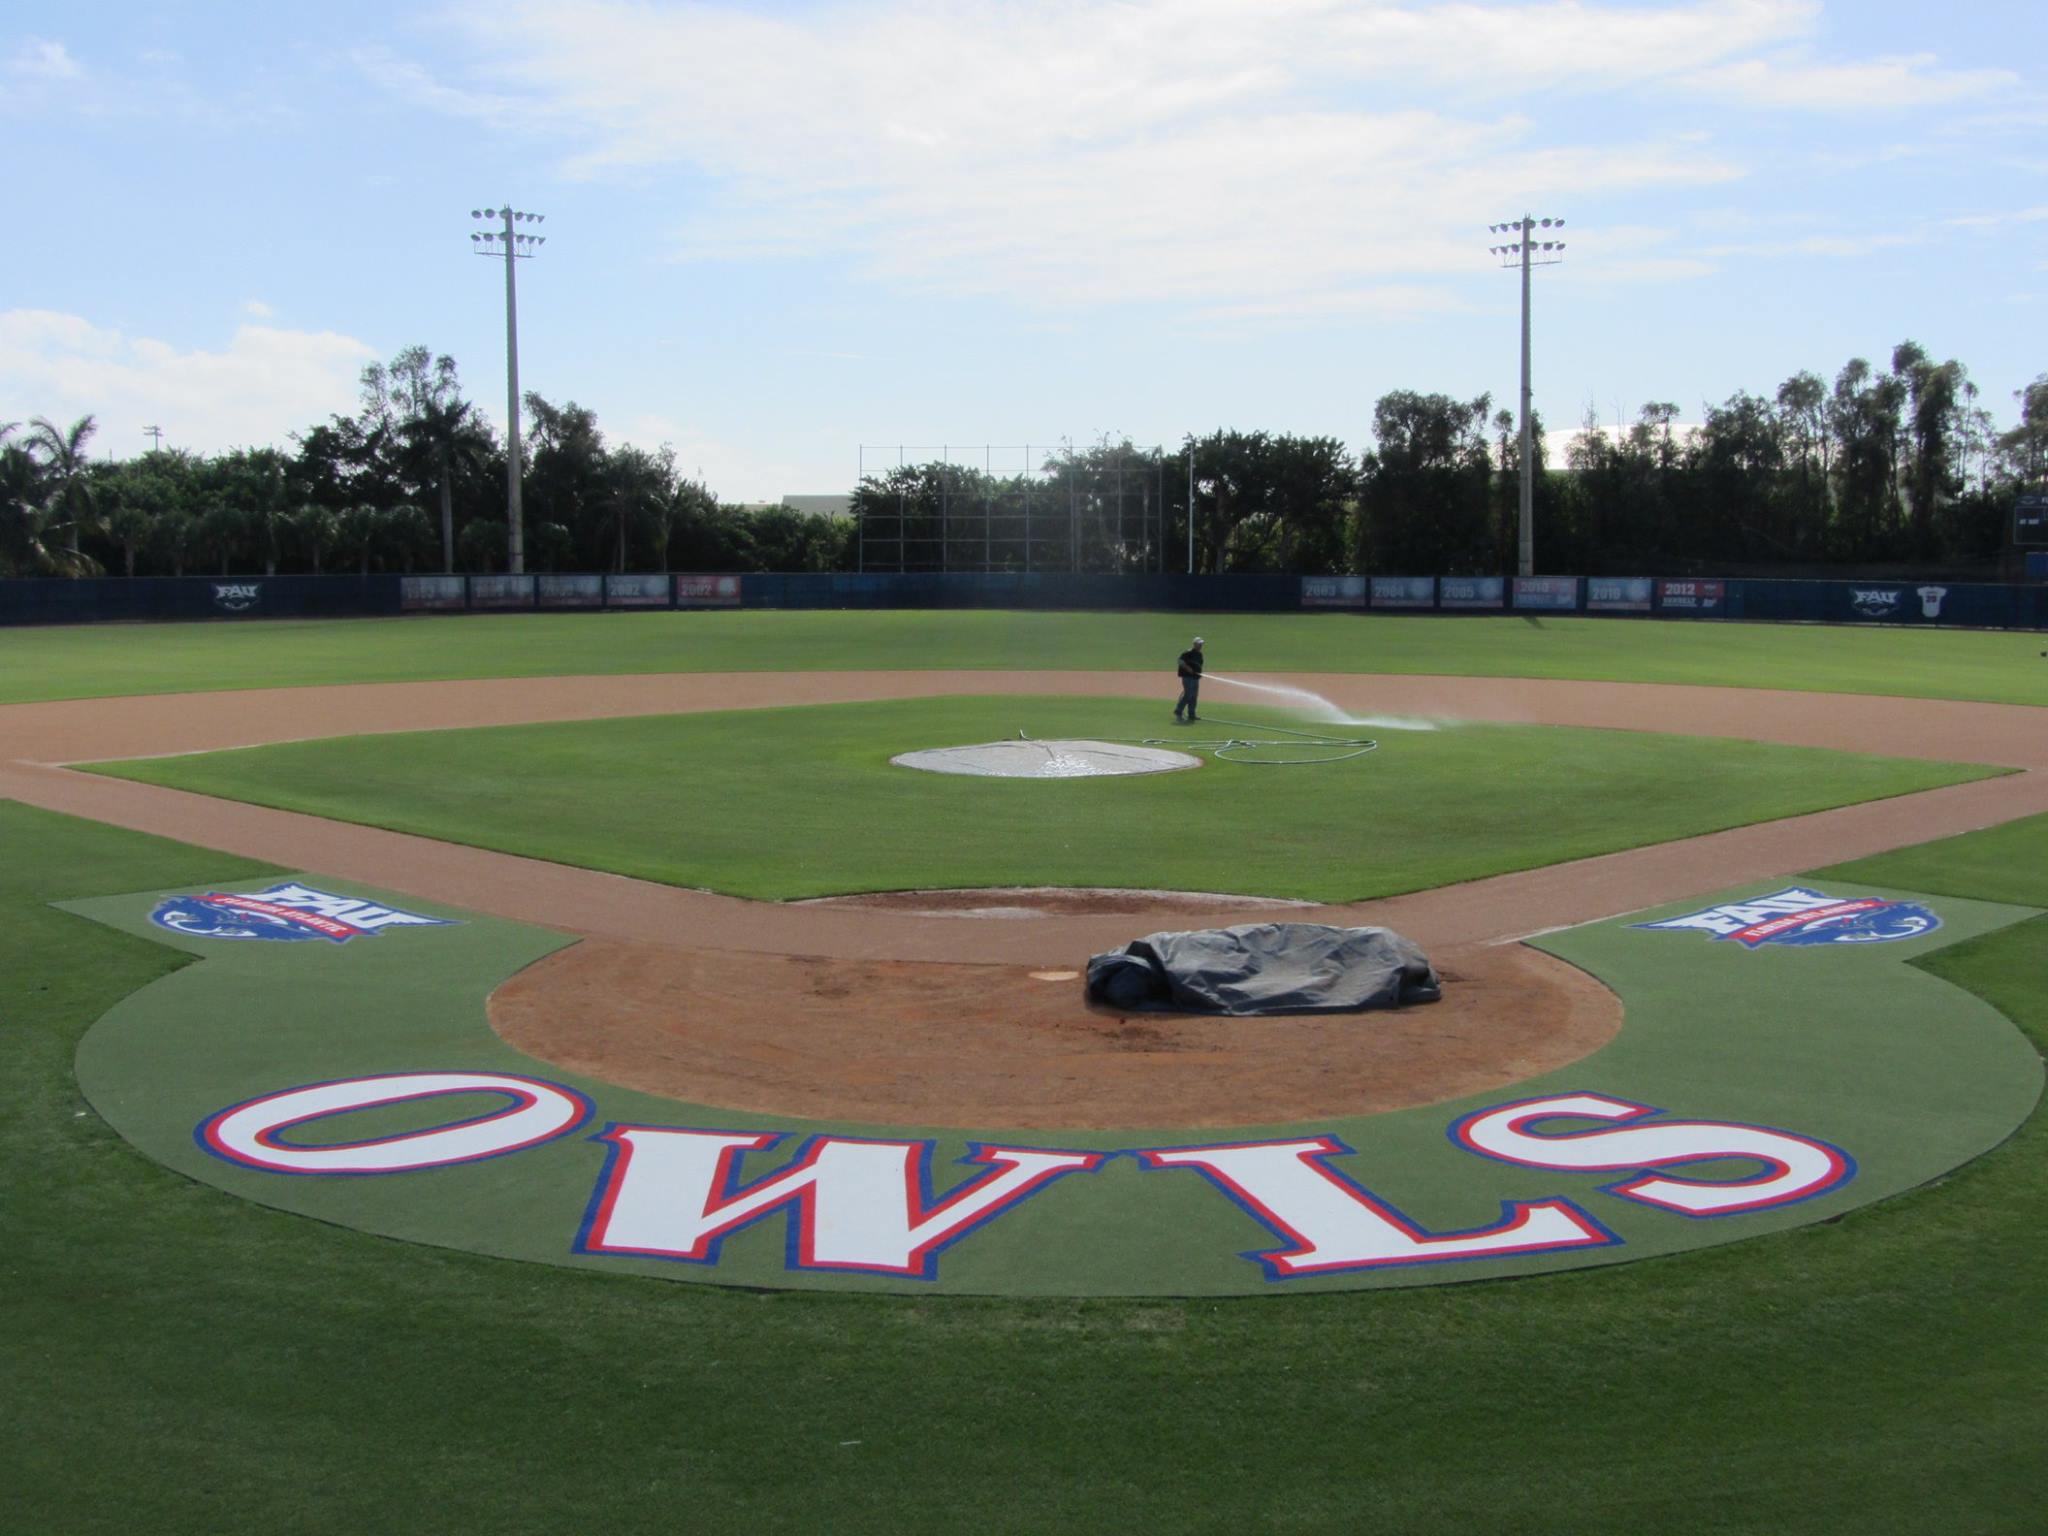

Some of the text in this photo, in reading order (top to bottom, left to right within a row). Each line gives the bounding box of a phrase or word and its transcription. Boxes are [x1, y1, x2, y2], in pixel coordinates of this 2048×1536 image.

[215, 585, 258, 599] FAU
[610, 583, 641, 596] 2002
[681, 583, 712, 596] 2002
[1305, 585, 1337, 597] 2003
[1665, 583, 1696, 595] 2012
[1854, 591, 1898, 604] FAU
[230, 884, 444, 929] FAU
[1648, 889, 1847, 935] FAU
[193, 1071, 1858, 1282] OWLS
